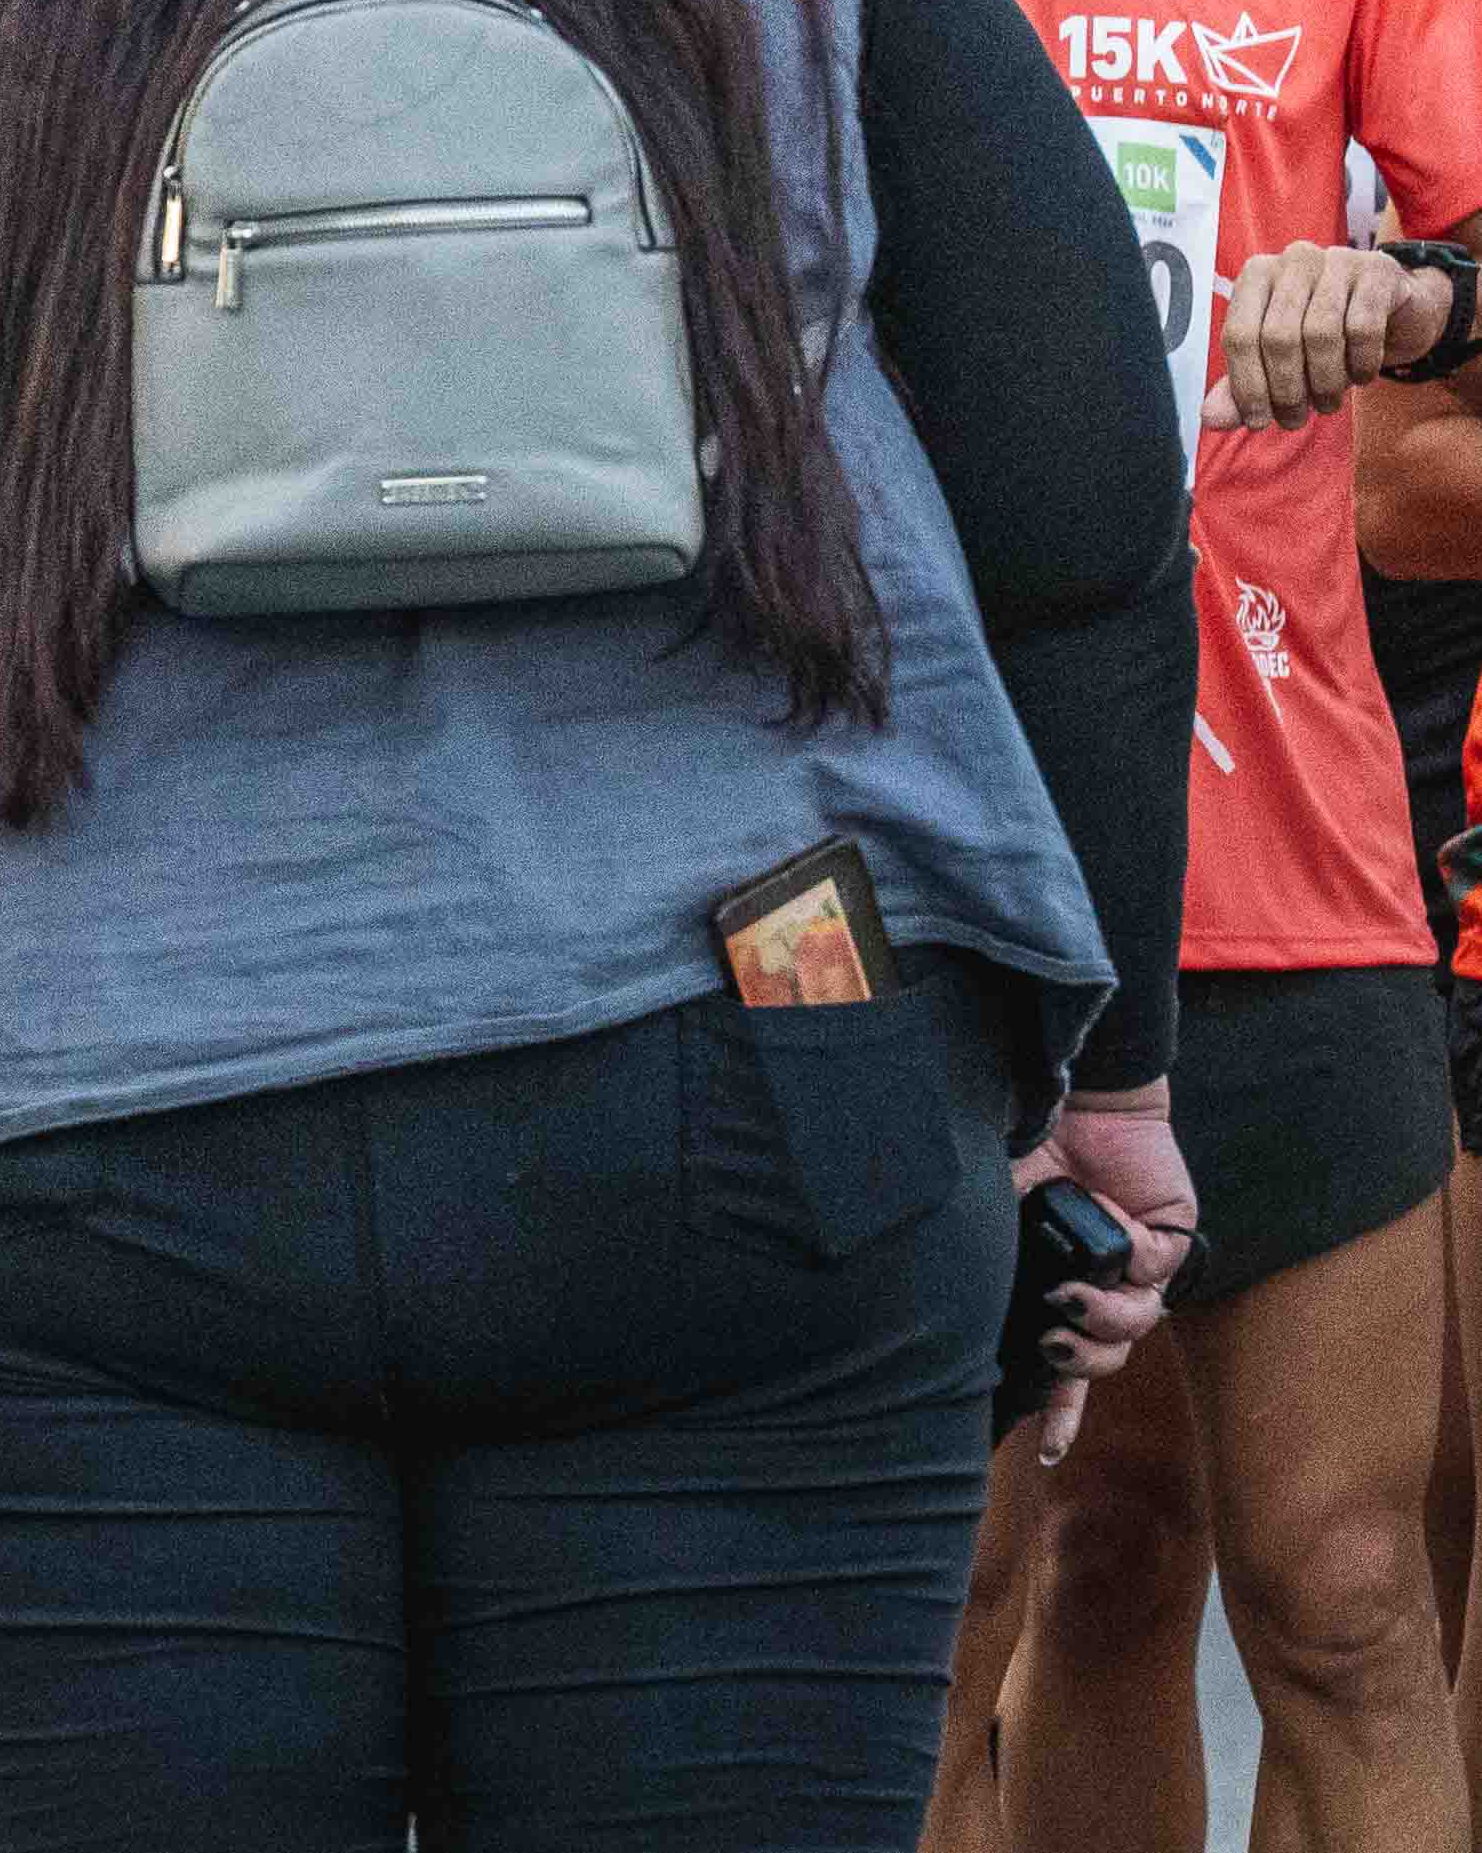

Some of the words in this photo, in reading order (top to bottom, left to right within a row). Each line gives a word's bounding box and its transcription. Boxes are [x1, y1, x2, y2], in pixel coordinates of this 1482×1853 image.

[1058, 15, 1188, 84] 15K
[1070, 85, 1189, 108] PUERTO
[1202, 92, 1278, 121] NORTE
[1123, 163, 1171, 191] 10K
